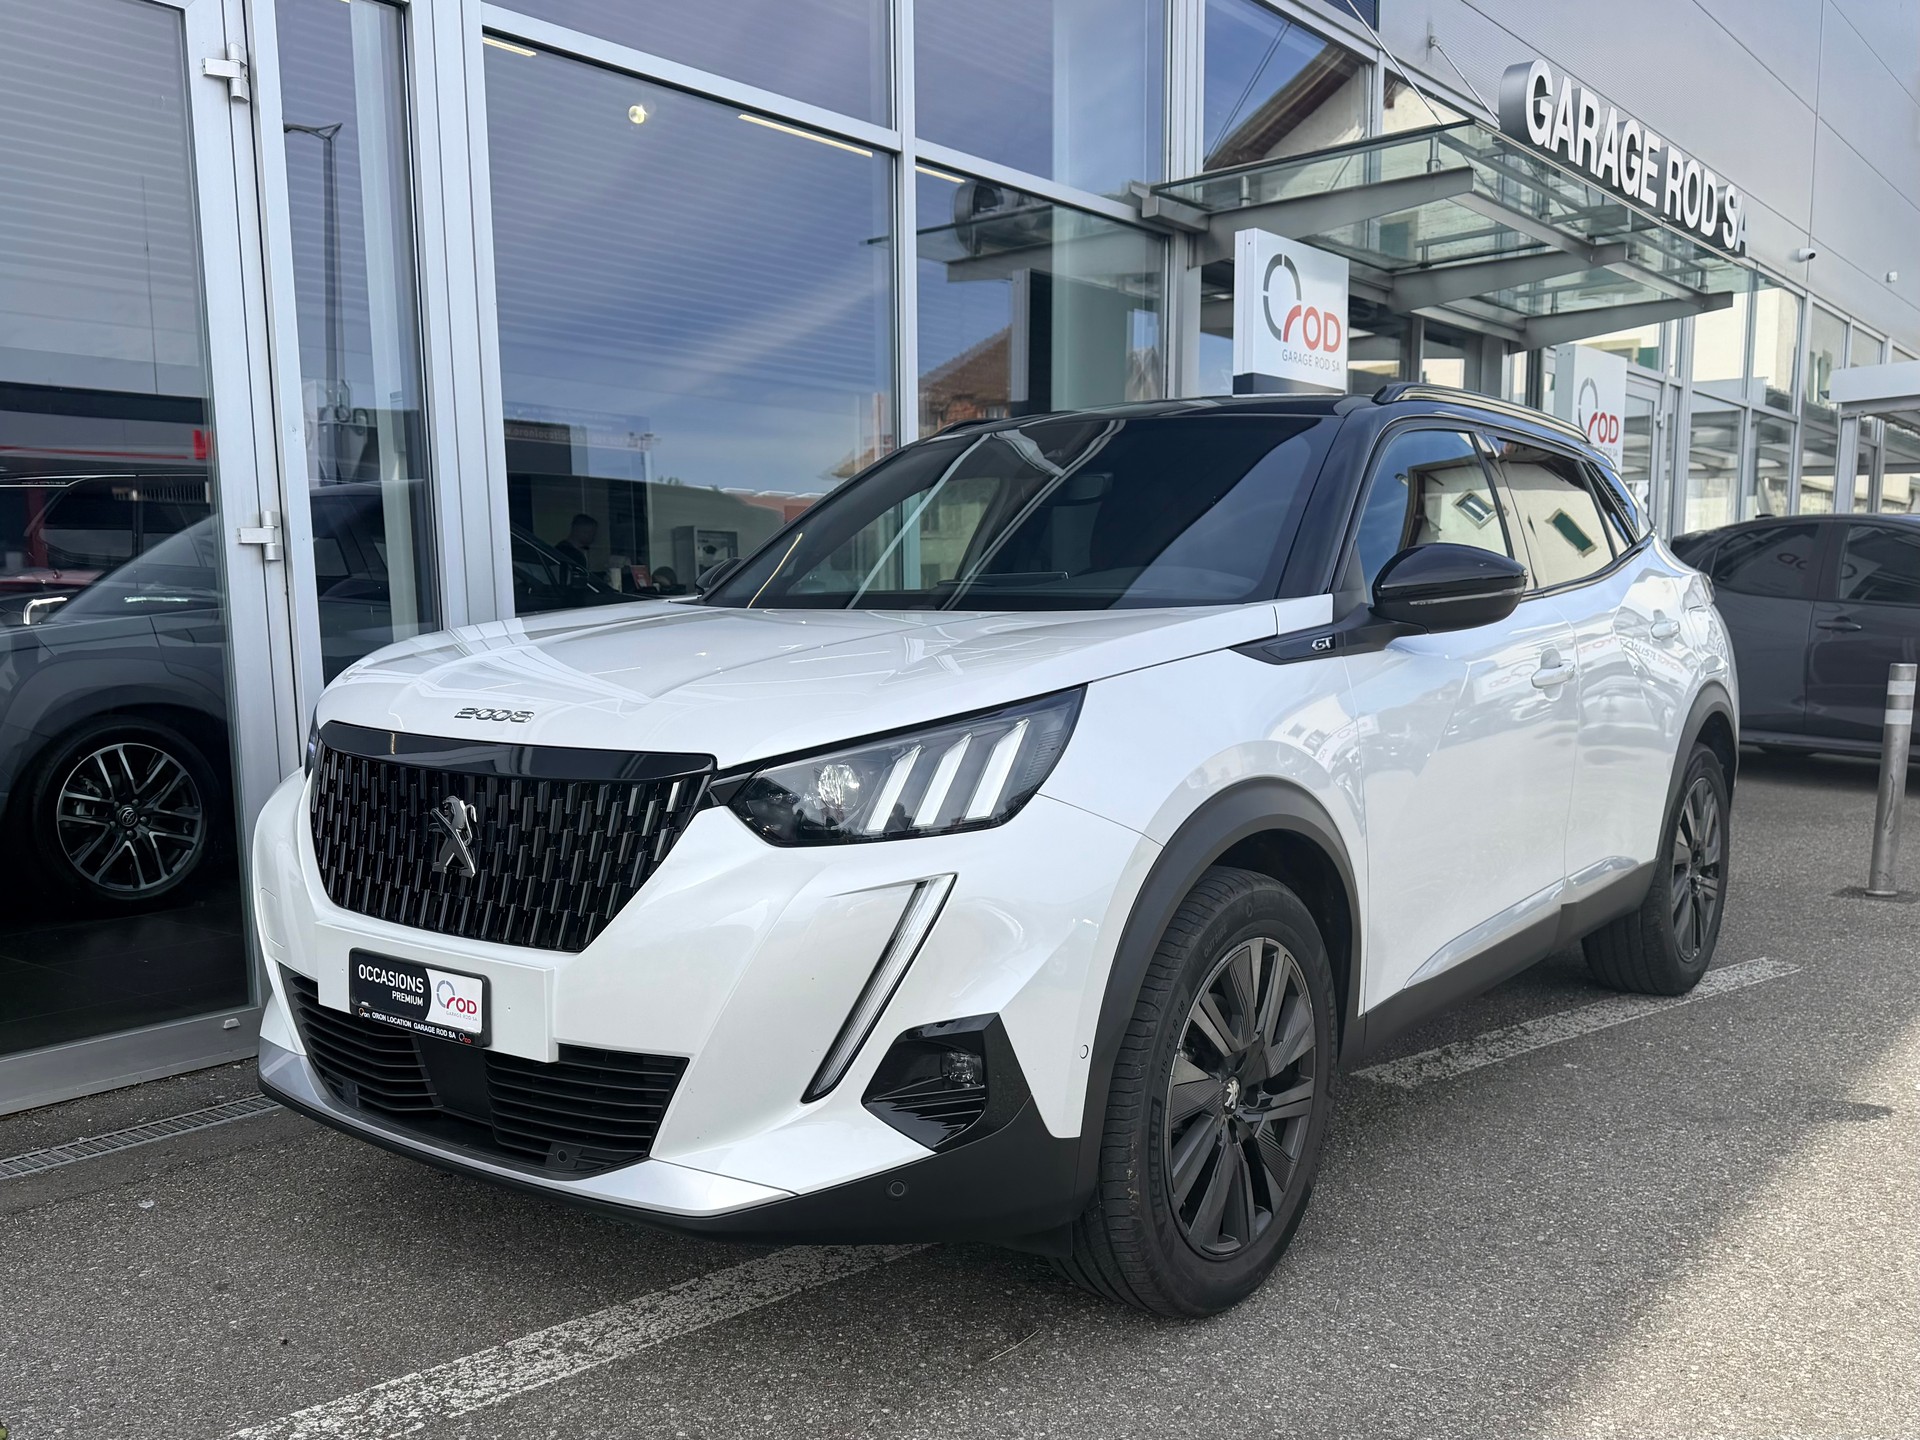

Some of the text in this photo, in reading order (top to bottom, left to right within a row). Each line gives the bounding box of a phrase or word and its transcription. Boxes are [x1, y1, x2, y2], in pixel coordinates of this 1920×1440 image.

[1525, 58, 1749, 252] GARAGE ROD SA
[1282, 349, 1341, 373] GARAGE ROD SA
[1311, 636, 1333, 651] GT
[453, 707, 536, 724] 2008
[358, 964, 424, 993] OCCASIONS
[391, 990, 423, 1006] PREMIUM
[371, 1011, 387, 1023] ORON
[386, 1015, 412, 1028] LOCATION
[413, 1022, 436, 1034] GARAGE
[435, 1028, 448, 1037] ROD
[448, 1030, 457, 1039] SA
[1149, 1105, 1164, 1225] MICHELIN
